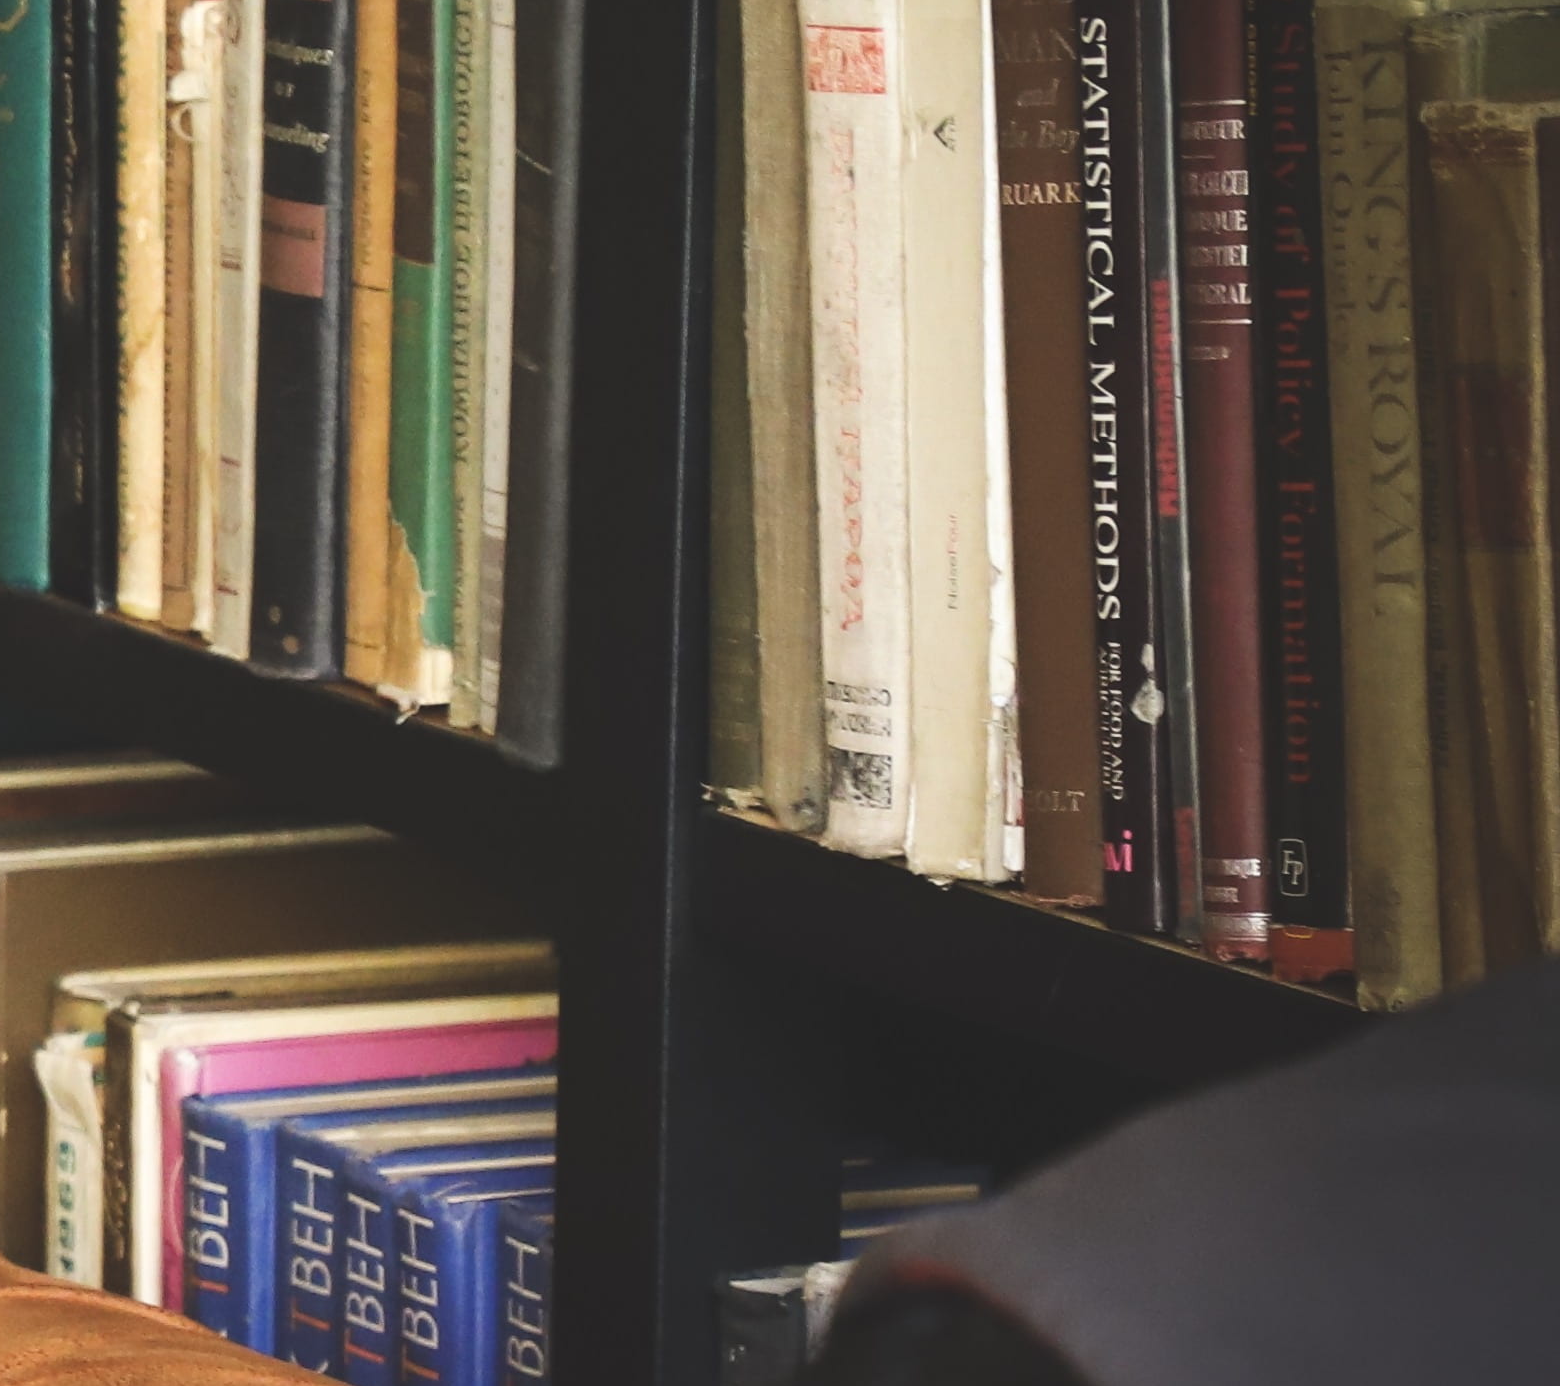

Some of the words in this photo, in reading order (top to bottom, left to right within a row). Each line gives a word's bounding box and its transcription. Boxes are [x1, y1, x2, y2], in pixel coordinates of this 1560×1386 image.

[1266, 22, 1310, 190] Study
[1322, 51, 1354, 157] John
[1001, 181, 1082, 206] RUARK
[1079, 17, 1116, 346] STATISTICAL
[1274, 206, 1310, 261] of
[1362, 40, 1407, 313] KING'S
[1271, 285, 1315, 456] Policy
[1087, 361, 1121, 623] METHODS
[1368, 344, 1416, 618] ROYAL
[1107, 641, 1122, 681] FOR
[1280, 480, 1317, 785] Formation
[1109, 689, 1123, 748] FOOD
[1111, 754, 1125, 801] AND
[1026, 789, 1086, 813] OLT
